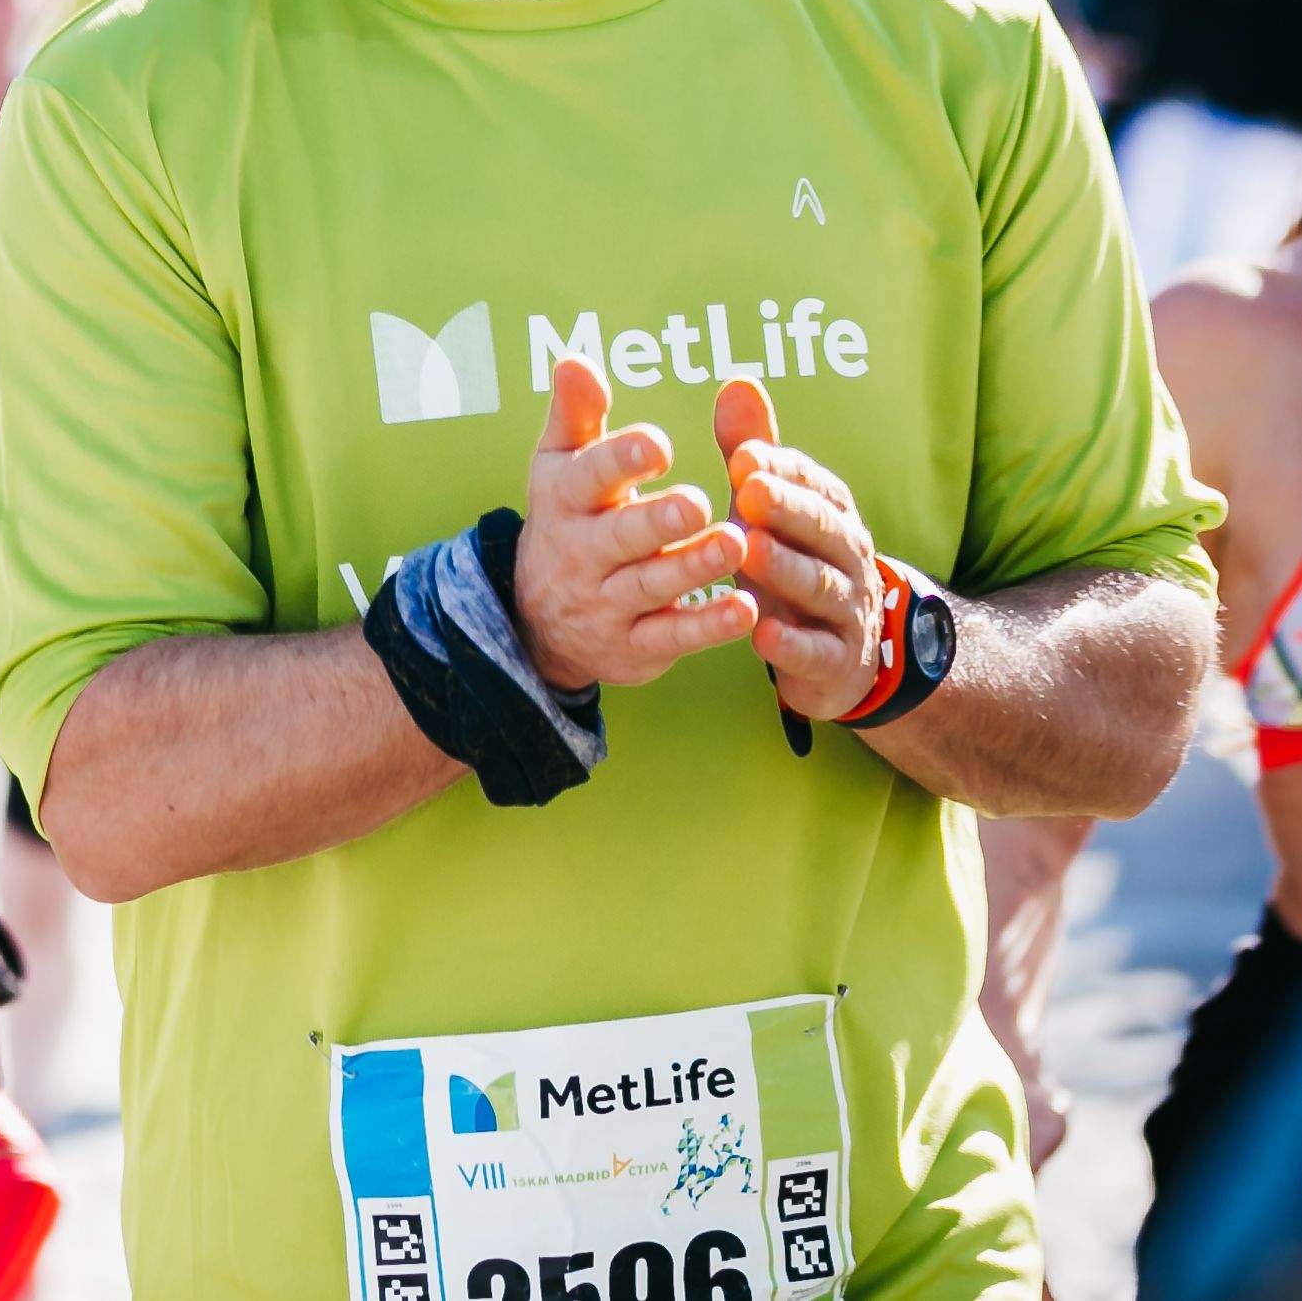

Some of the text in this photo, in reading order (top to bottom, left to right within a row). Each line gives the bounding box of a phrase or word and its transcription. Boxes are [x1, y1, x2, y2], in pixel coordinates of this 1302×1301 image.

[527, 297, 870, 393] MetLife
[539, 1058, 736, 1119] MetLife
[456, 1161, 507, 1190] VIII
[554, 1169, 611, 1185] MADRID
